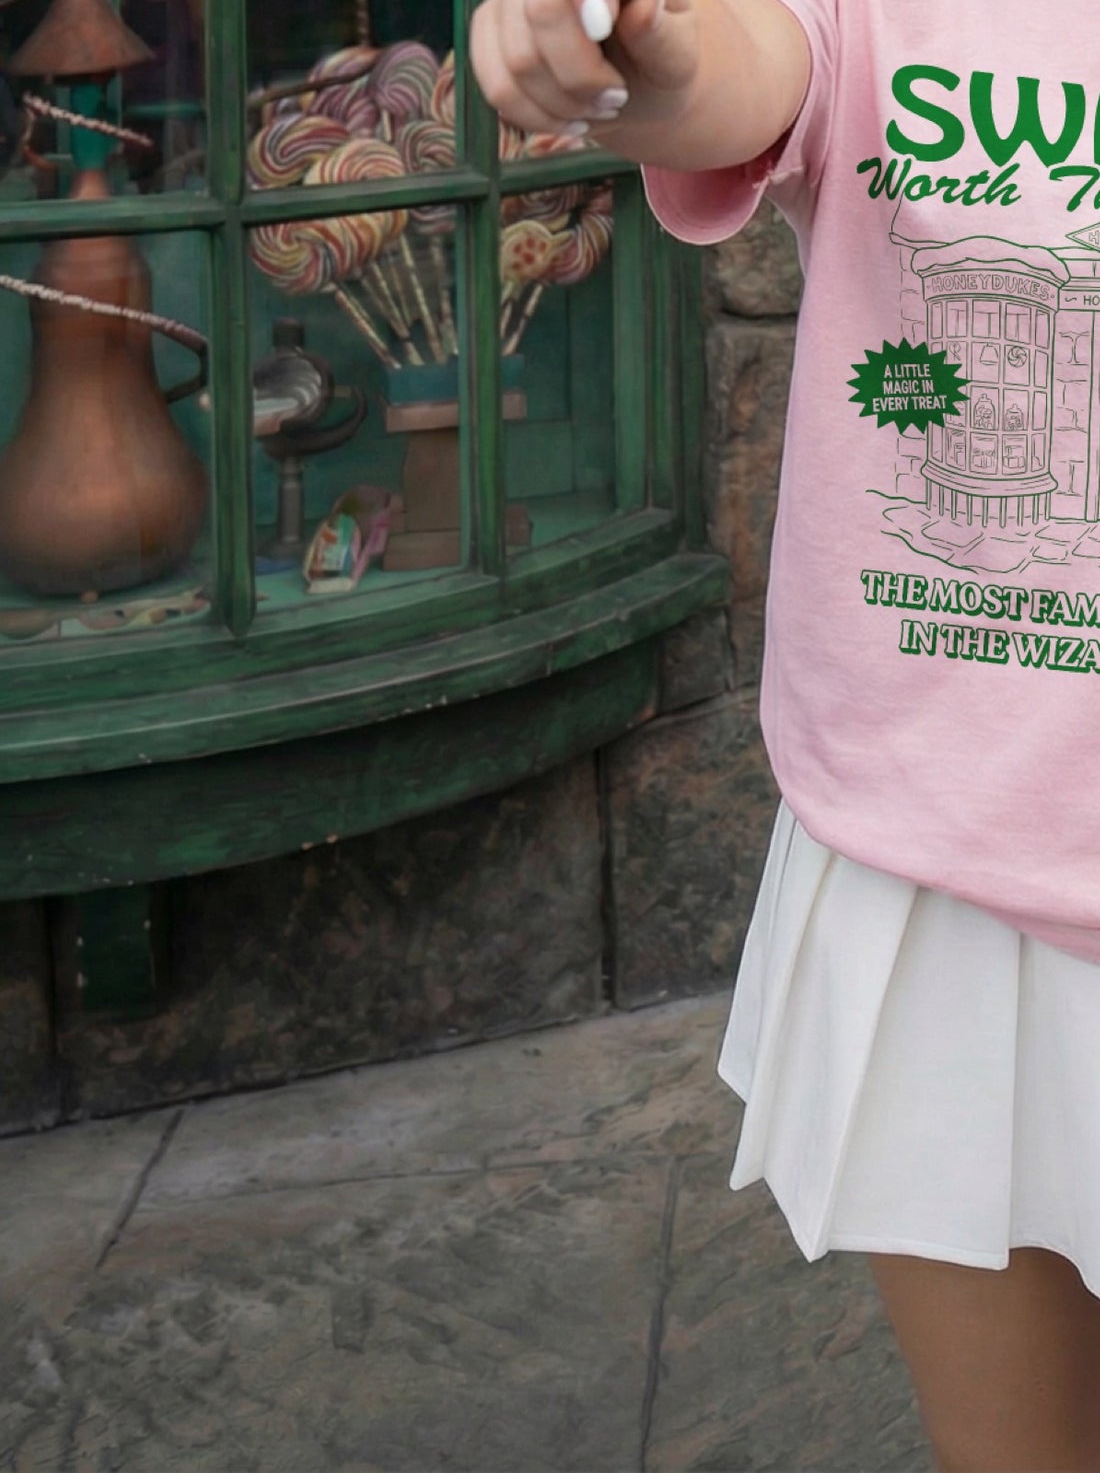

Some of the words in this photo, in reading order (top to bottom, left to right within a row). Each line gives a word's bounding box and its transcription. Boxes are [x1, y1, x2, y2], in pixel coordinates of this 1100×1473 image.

[856, 157, 1022, 207] Worth
[931, 274, 1050, 300] HONEYDUKES
[884, 364, 892, 378] A
[895, 364, 931, 378] LITTLE
[883, 380, 920, 394] MAGIC
[922, 379, 934, 393] IN
[873, 397, 909, 412] EVERY
[911, 395, 947, 410] TREAT
[861, 570, 928, 610] THE
[929, 578, 1028, 621] MOST
[899, 619, 938, 655] IN
[940, 624, 1010, 664] THE
